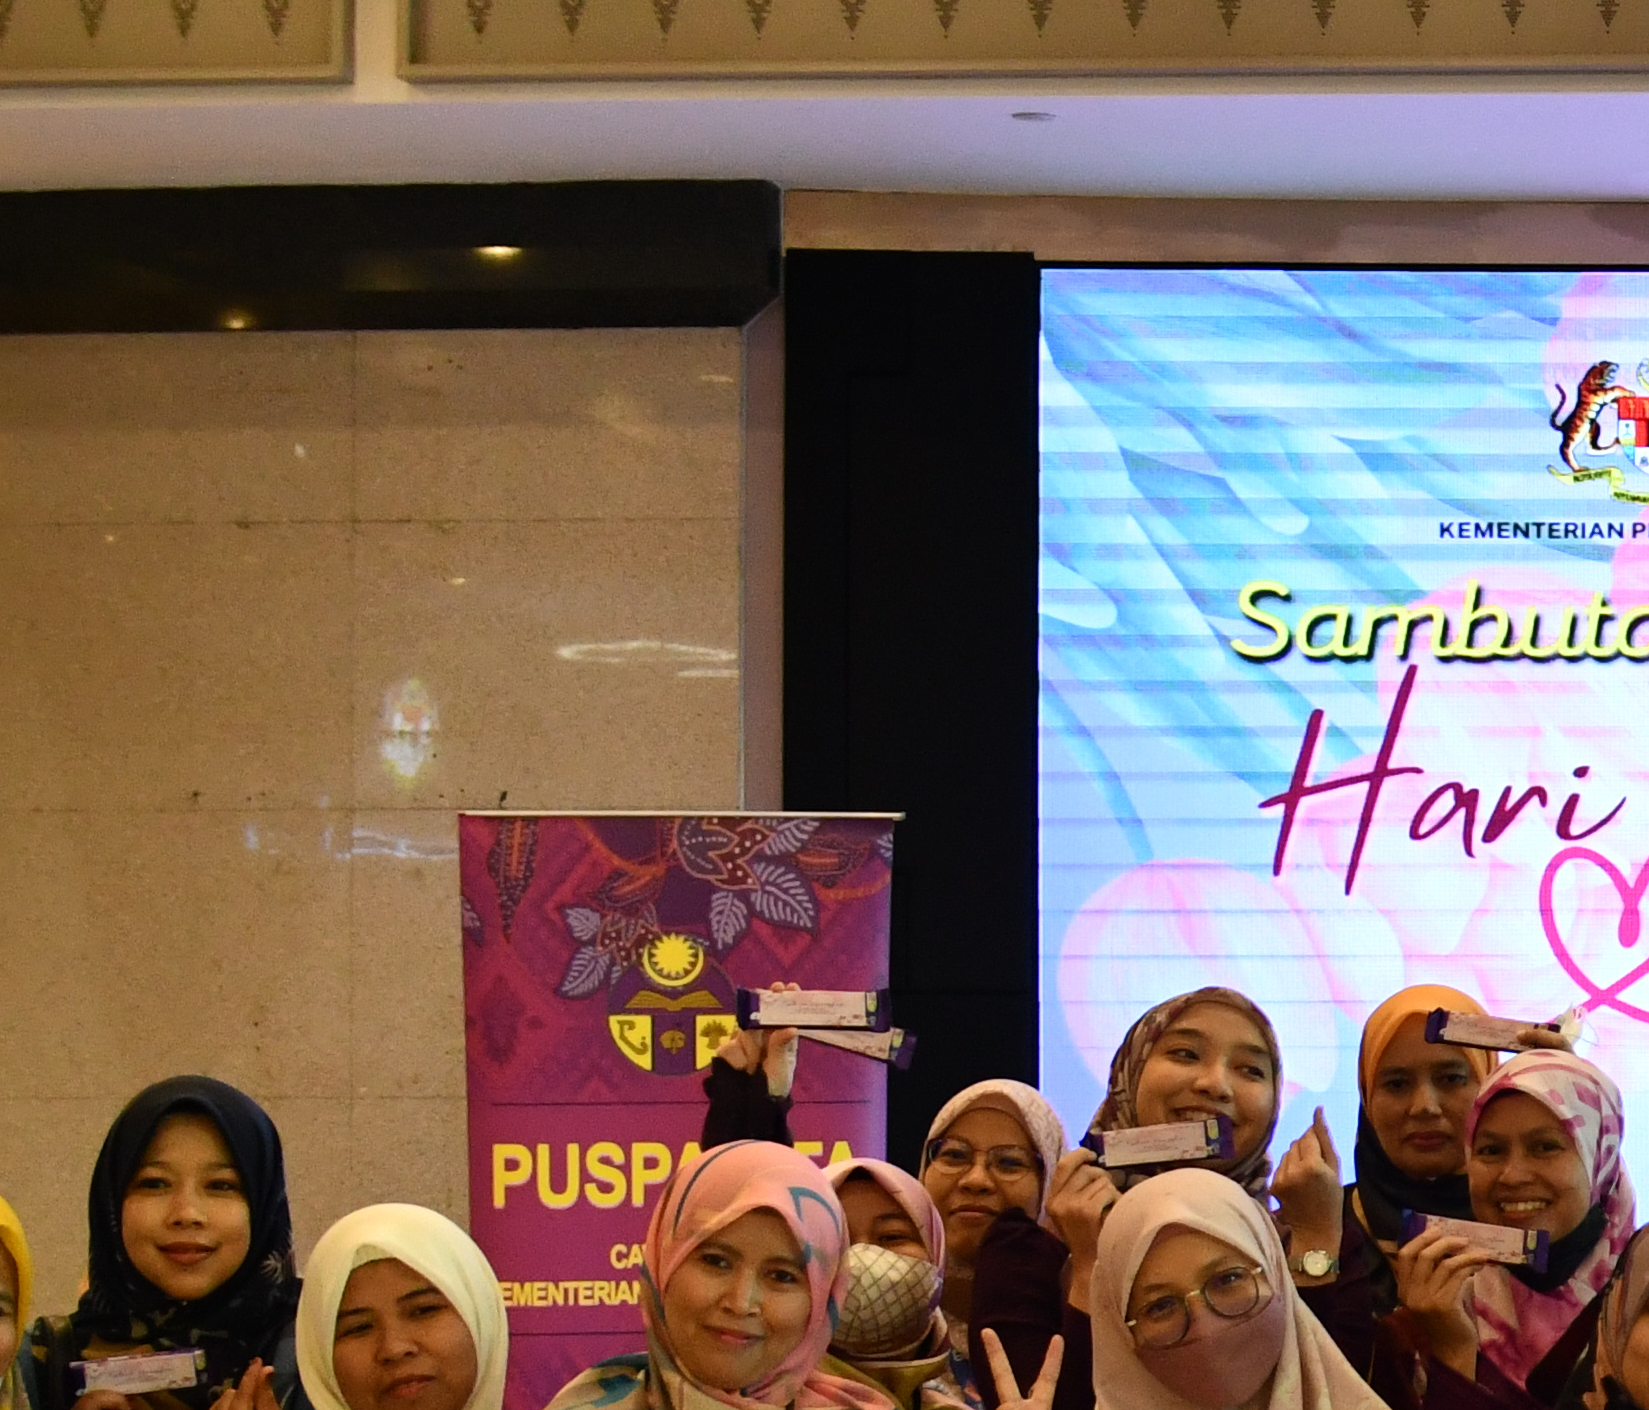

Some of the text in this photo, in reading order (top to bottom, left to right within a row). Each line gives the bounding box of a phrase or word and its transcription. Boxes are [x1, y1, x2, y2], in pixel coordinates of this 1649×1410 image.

[1437, 520, 1625, 541] KEMENTERIAN
[1258, 662, 1628, 896] Hari
[499, 1280, 642, 1307] EMENTERIAN
